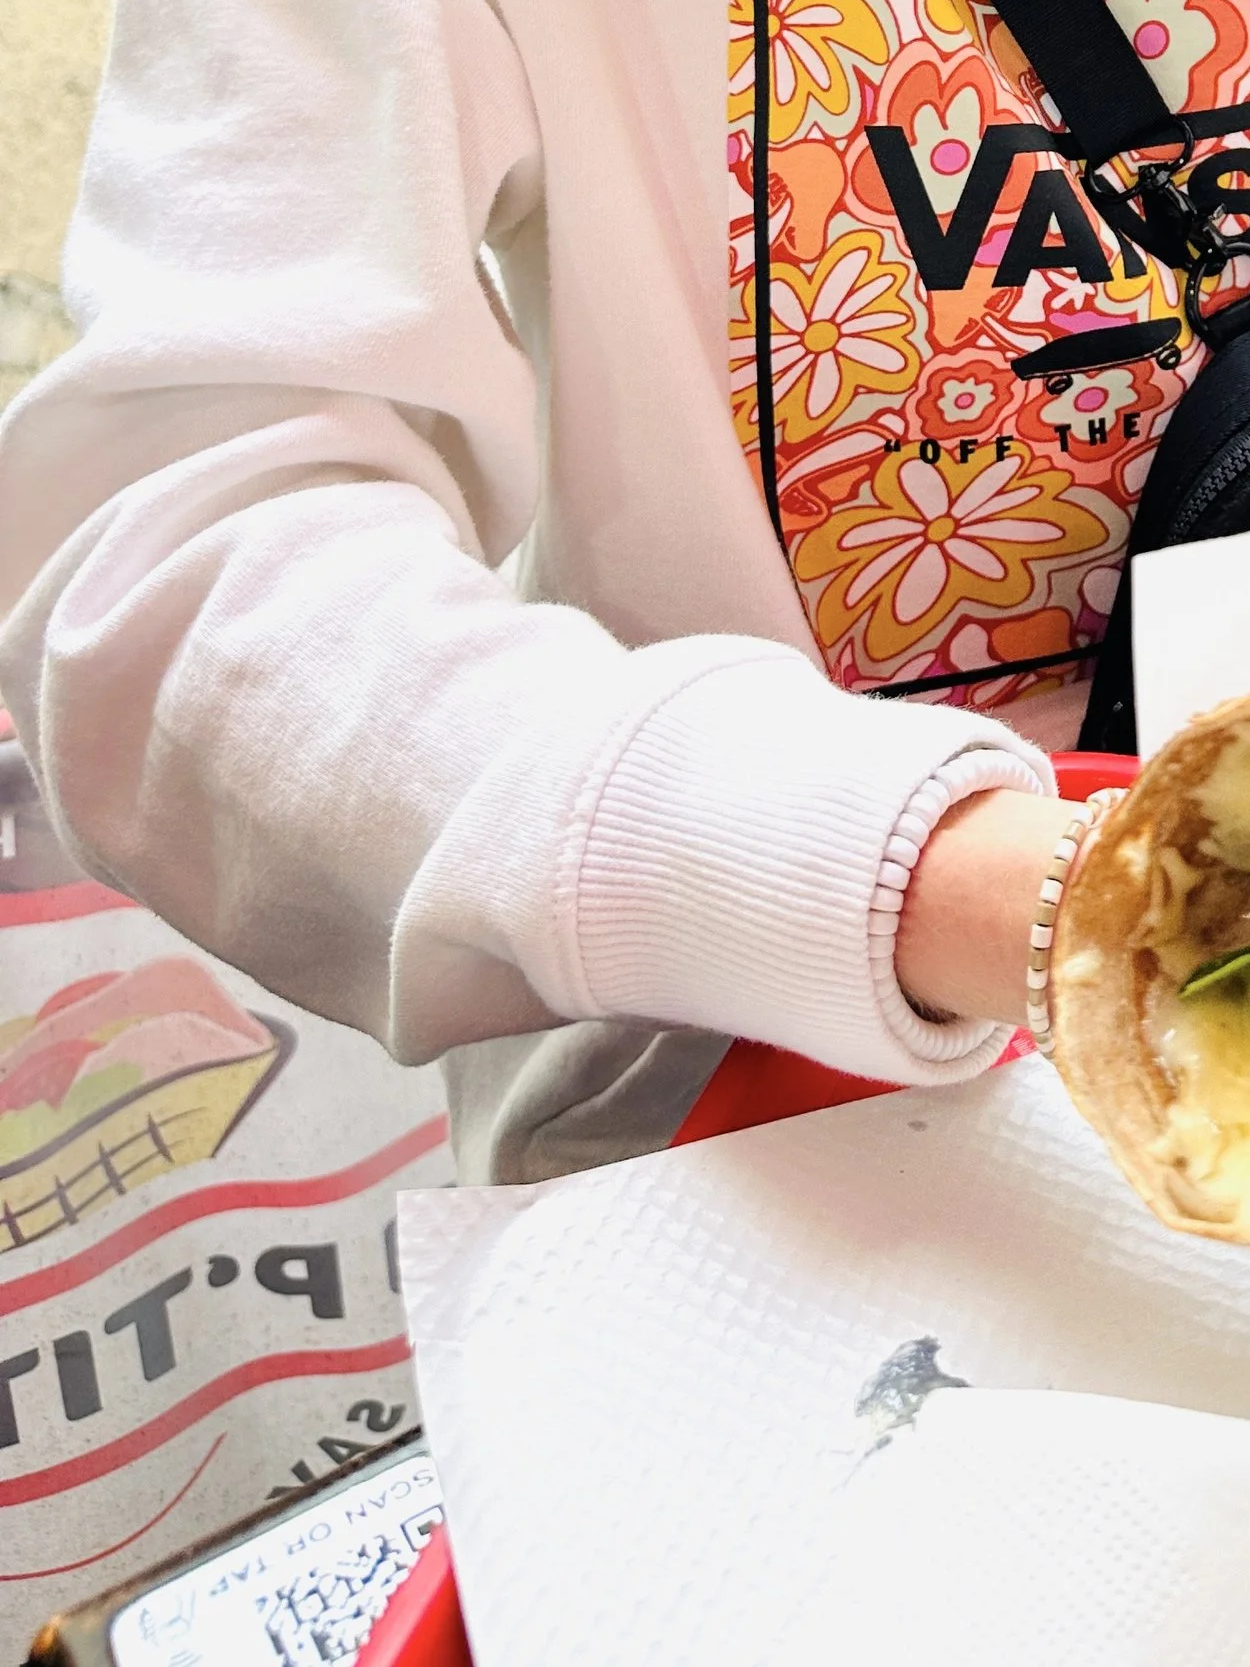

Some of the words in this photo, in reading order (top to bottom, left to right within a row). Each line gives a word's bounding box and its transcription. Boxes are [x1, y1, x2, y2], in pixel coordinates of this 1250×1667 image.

[1054, 412, 1141, 453] THE
[345, 1468, 435, 1525] SCAN
[285, 1521, 332, 1557] OR
[207, 1555, 269, 1598] TAP
